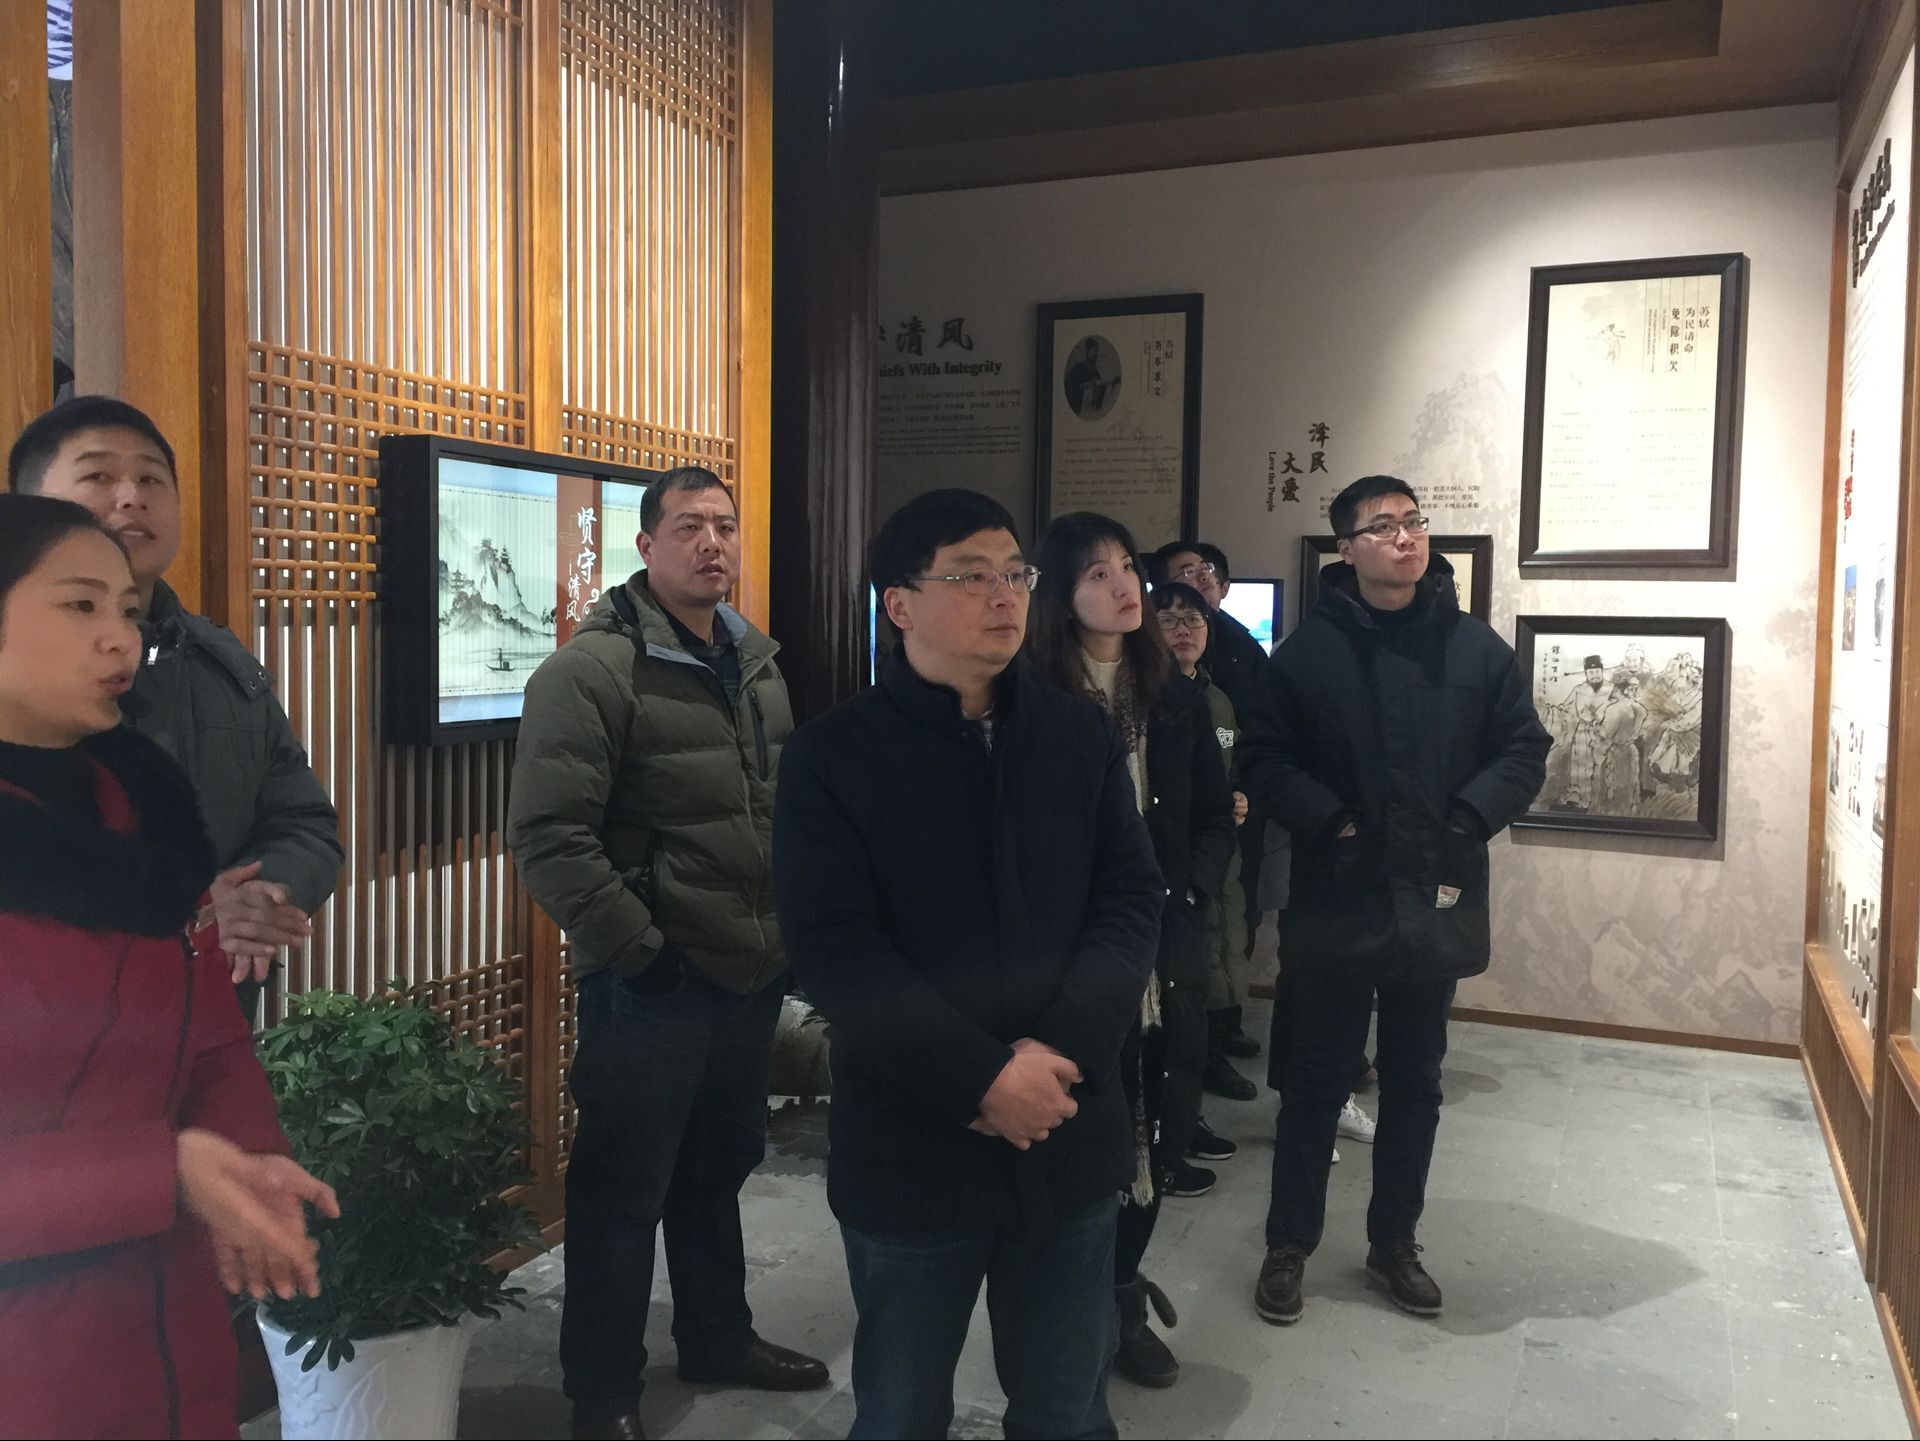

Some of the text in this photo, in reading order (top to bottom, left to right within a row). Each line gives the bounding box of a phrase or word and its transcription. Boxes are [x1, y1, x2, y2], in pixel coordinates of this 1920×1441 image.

[878, 315, 974, 356] 清风
[1669, 307, 1681, 372] 免除积欠
[908, 362, 940, 376] With
[944, 359, 1003, 377] Integrity
[1266, 451, 1277, 512] Love the People
[577, 506, 597, 585] 贤守
